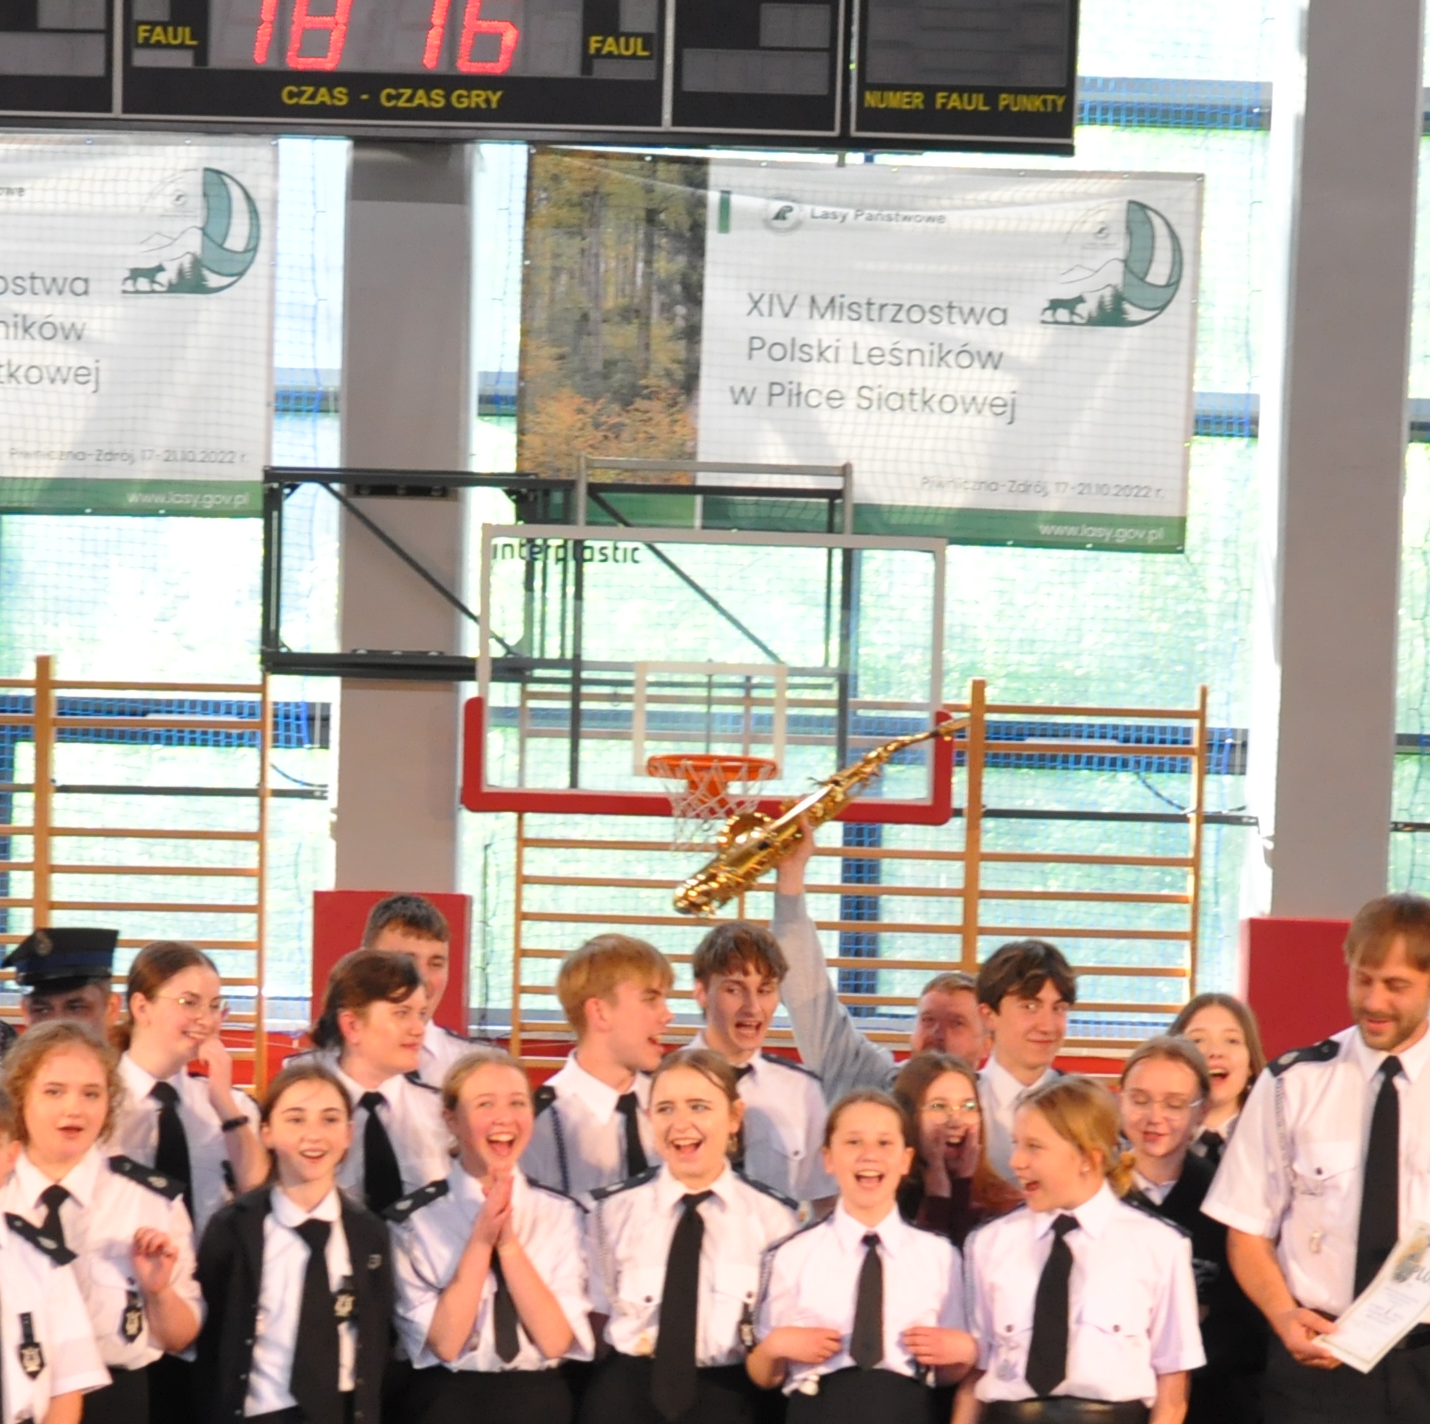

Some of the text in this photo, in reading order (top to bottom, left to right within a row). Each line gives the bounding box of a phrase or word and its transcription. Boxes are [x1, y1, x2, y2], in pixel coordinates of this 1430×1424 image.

[137, 25, 198, 45] FAUL
[589, 36, 650, 56] FAUL
[281, 86, 349, 106] CZAS
[380, 88, 445, 108] CZAS
[451, 89, 503, 108] GRY
[864, 90, 1066, 112] NUMER FAUL PUNKTY
[811, 208, 946, 224] Lasy Państwowe
[747, 292, 1008, 326] XIV Mistrzostwa
[748, 336, 1003, 370] Polski Leśników
[730, 381, 1017, 425] w Piłce Siatkowej
[127, 491, 249, 508] www.lasy.gov.pl
[1039, 522, 1165, 542] www.lasy.gov.pl
[492, 541, 640, 565] interplastic
